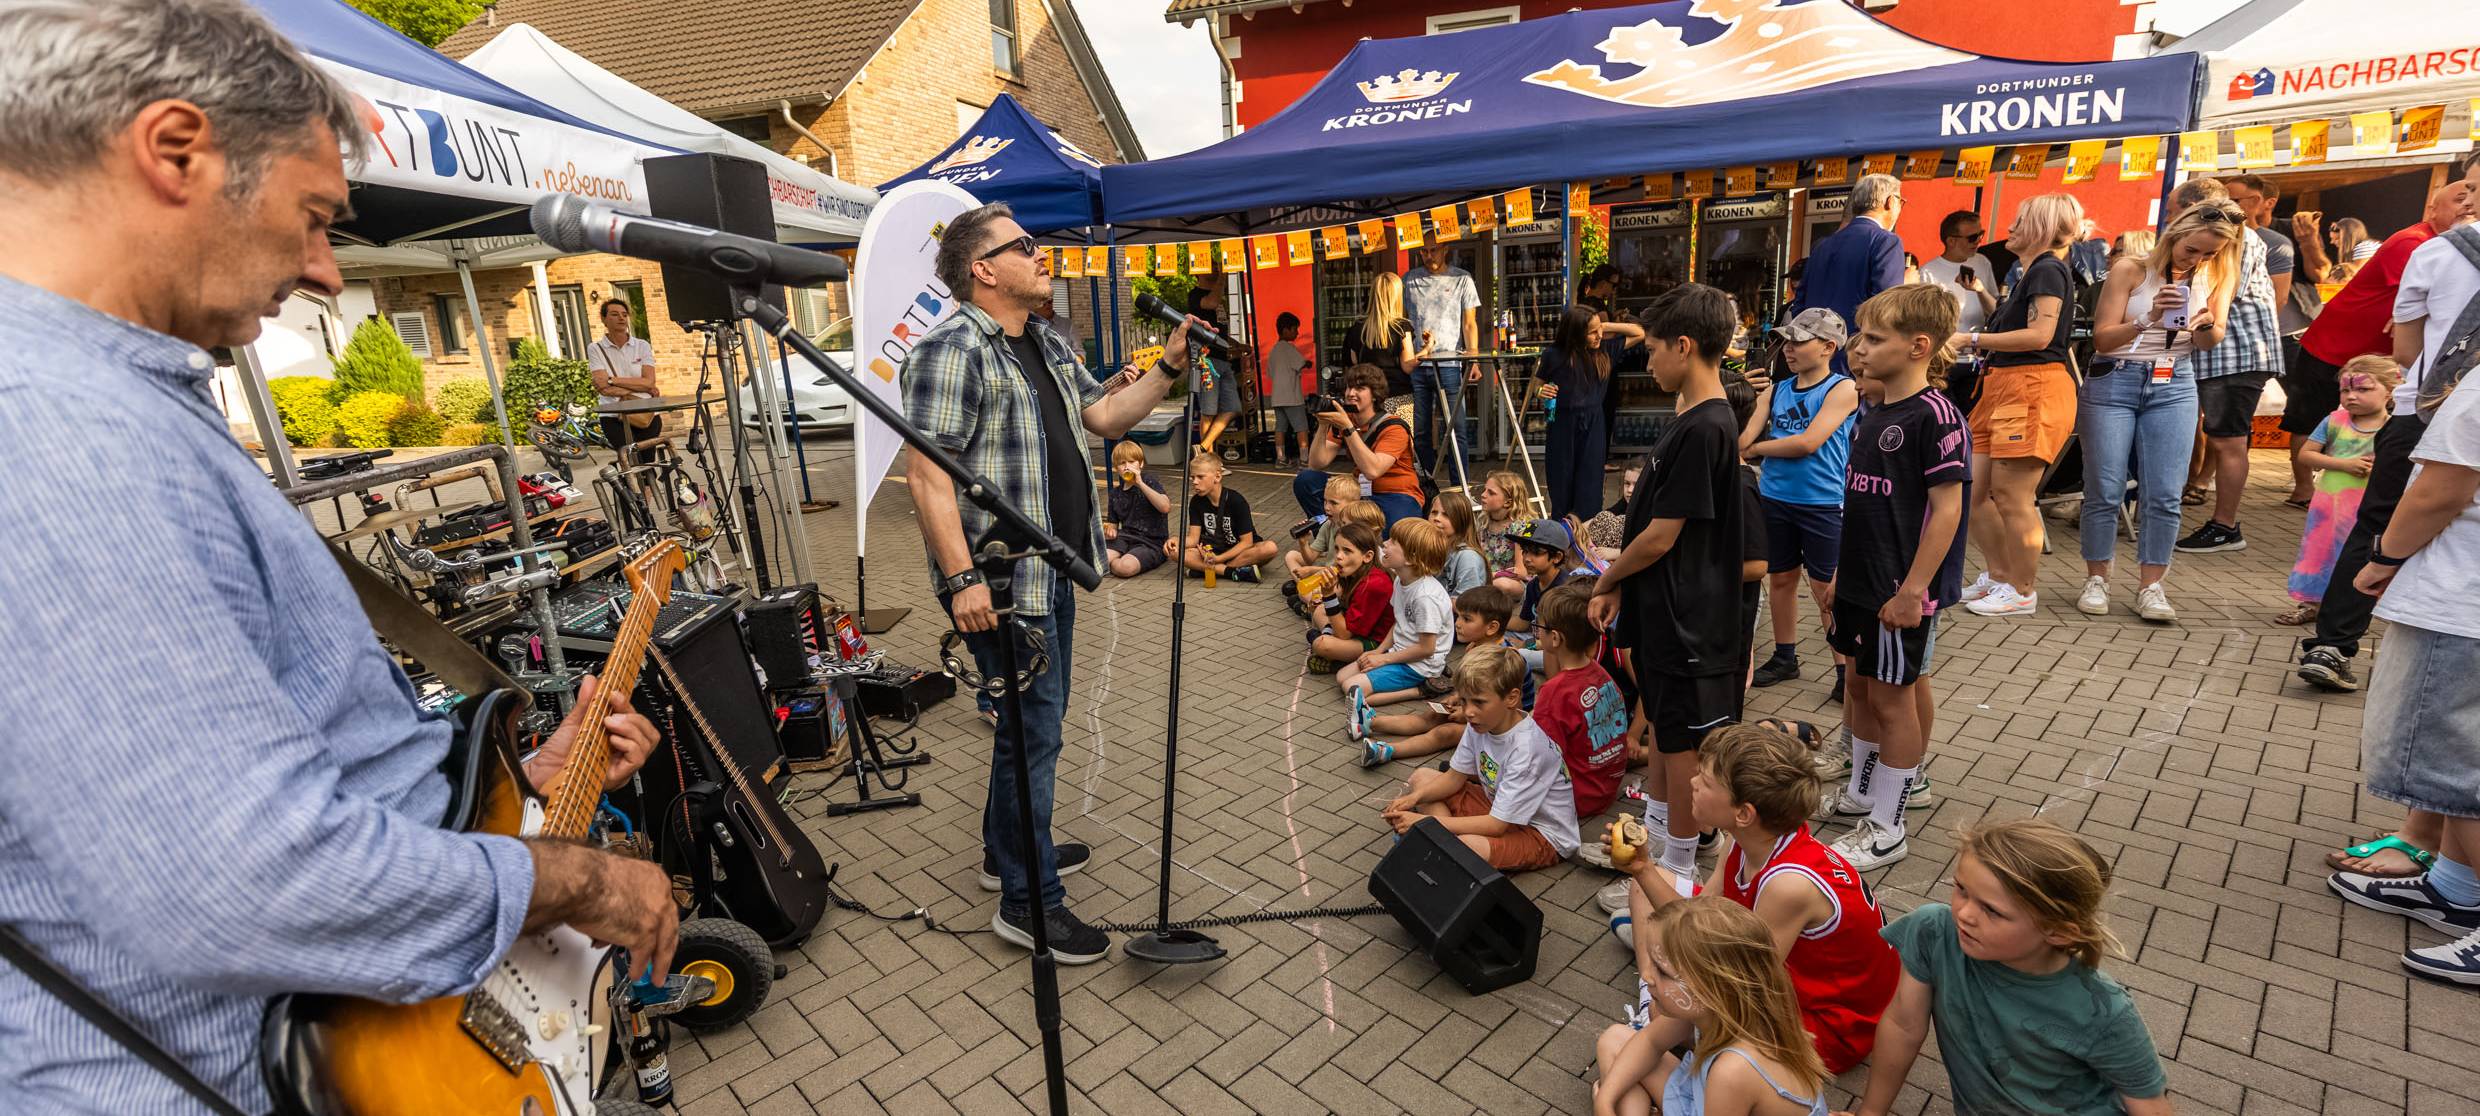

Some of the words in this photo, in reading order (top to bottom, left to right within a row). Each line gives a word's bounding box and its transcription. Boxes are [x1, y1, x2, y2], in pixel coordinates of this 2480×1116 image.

[1977, 74, 2094, 94] DORTMUNDER
[1322, 99, 1473, 132] KRONEN
[1355, 98, 1448, 114] DORTMUNDER
[1940, 88, 2126, 136] KRONEN
[1615, 214, 1660, 228] KRONEN
[1707, 207, 1754, 220] KRONEN
[1506, 223, 1543, 234] KRONEN
[1851, 472, 1892, 497] XBTO
[1858, 750, 1880, 796] SKECHERS
